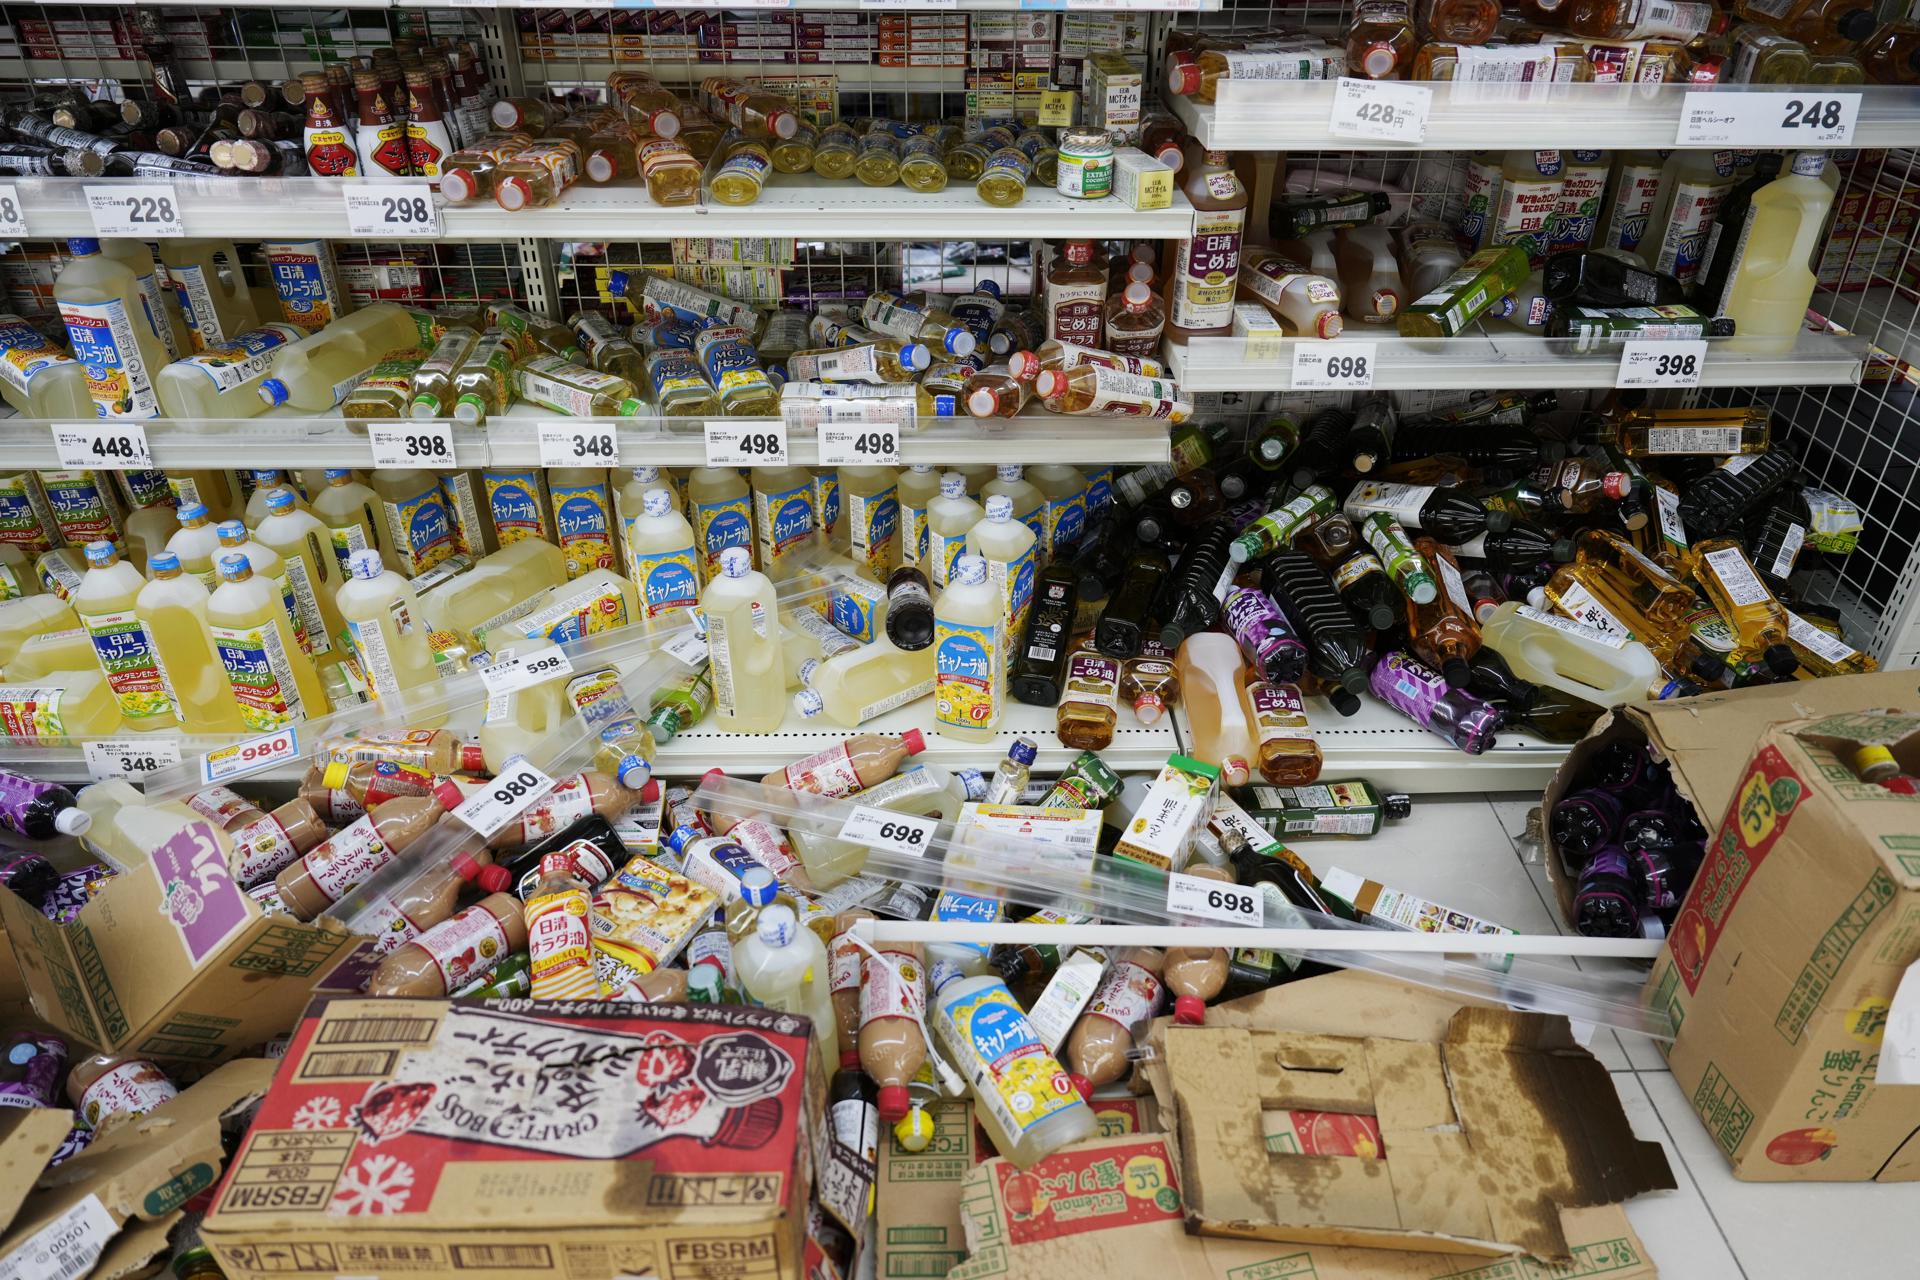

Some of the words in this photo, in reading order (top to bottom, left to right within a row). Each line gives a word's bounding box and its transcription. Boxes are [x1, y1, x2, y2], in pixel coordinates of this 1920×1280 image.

[1109, 95, 1138, 104] MCTオイル
[1356, 102, 1394, 124] 428
[1781, 100, 1842, 129] 248
[1144, 186, 1167, 194] MCTオイル
[126, 197, 175, 222] 228
[382, 198, 428, 222] 298
[1520, 217, 1542, 230] 日清
[1206, 236, 1232, 251] 日清
[1194, 252, 1238, 271] こめ油
[280, 266, 304, 279] 日清
[1072, 306, 1088, 314] 日清
[1058, 317, 1098, 332] こめ油
[72, 328, 96, 344] 日清
[1063, 334, 1094, 345] プラス
[715, 348, 745, 360] MCT
[1327, 356, 1366, 378] 698
[1656, 355, 1696, 376] 398
[92, 436, 133, 458] 448
[406, 436, 446, 456] 398
[572, 434, 614, 456] 348
[740, 434, 780, 454] 498
[854, 433, 895, 454] 498
[59, 490, 80, 499] 日清
[493, 502, 536, 518] キャノーラ油
[560, 513, 605, 532] キャノーラ油
[775, 514, 812, 539] キャノーラ油
[707, 526, 750, 551] キャノーラ油
[648, 578, 696, 602] キャノーラ油
[112, 634, 136, 646] 日清
[226, 650, 246, 660] 日清
[526, 656, 560, 674] 598
[938, 651, 988, 677] キャノーラ油
[1084, 658, 1106, 668] 日清
[1073, 666, 1114, 680] こめ油
[1266, 688, 1288, 698] 日清
[972, 708, 984, 720] 0
[1258, 698, 1301, 710] こめ油
[242, 738, 288, 760] 980
[120, 757, 158, 772] 348
[836, 767, 857, 787] CRAFT
[494, 772, 538, 805] 980
[880, 822, 924, 844] 698
[940, 894, 996, 920] キャノーラ油
[1208, 890, 1254, 914] 698
[540, 916, 568, 936] 日清
[530, 930, 584, 957] サラダ油
[692, 1007, 773, 1028] クラフトボス
[974, 1016, 1040, 1058] キャノーラ油
[454, 1028, 635, 1078] ミルクティー
[714, 1058, 770, 1081] 練乳
[1054, 1078, 1069, 1094] 0
[1806, 1050, 1862, 1122] 蜜りんご
[436, 1092, 500, 1132] BOSS
[520, 1112, 599, 1142] CRAFT
[1721, 1102, 1750, 1150] FC5M
[1040, 1159, 1123, 1200] 蜜りんご
[228, 1185, 326, 1207] FBSRM
[49, 1220, 92, 1255] 00501
[674, 1239, 773, 1261] FBSRM
